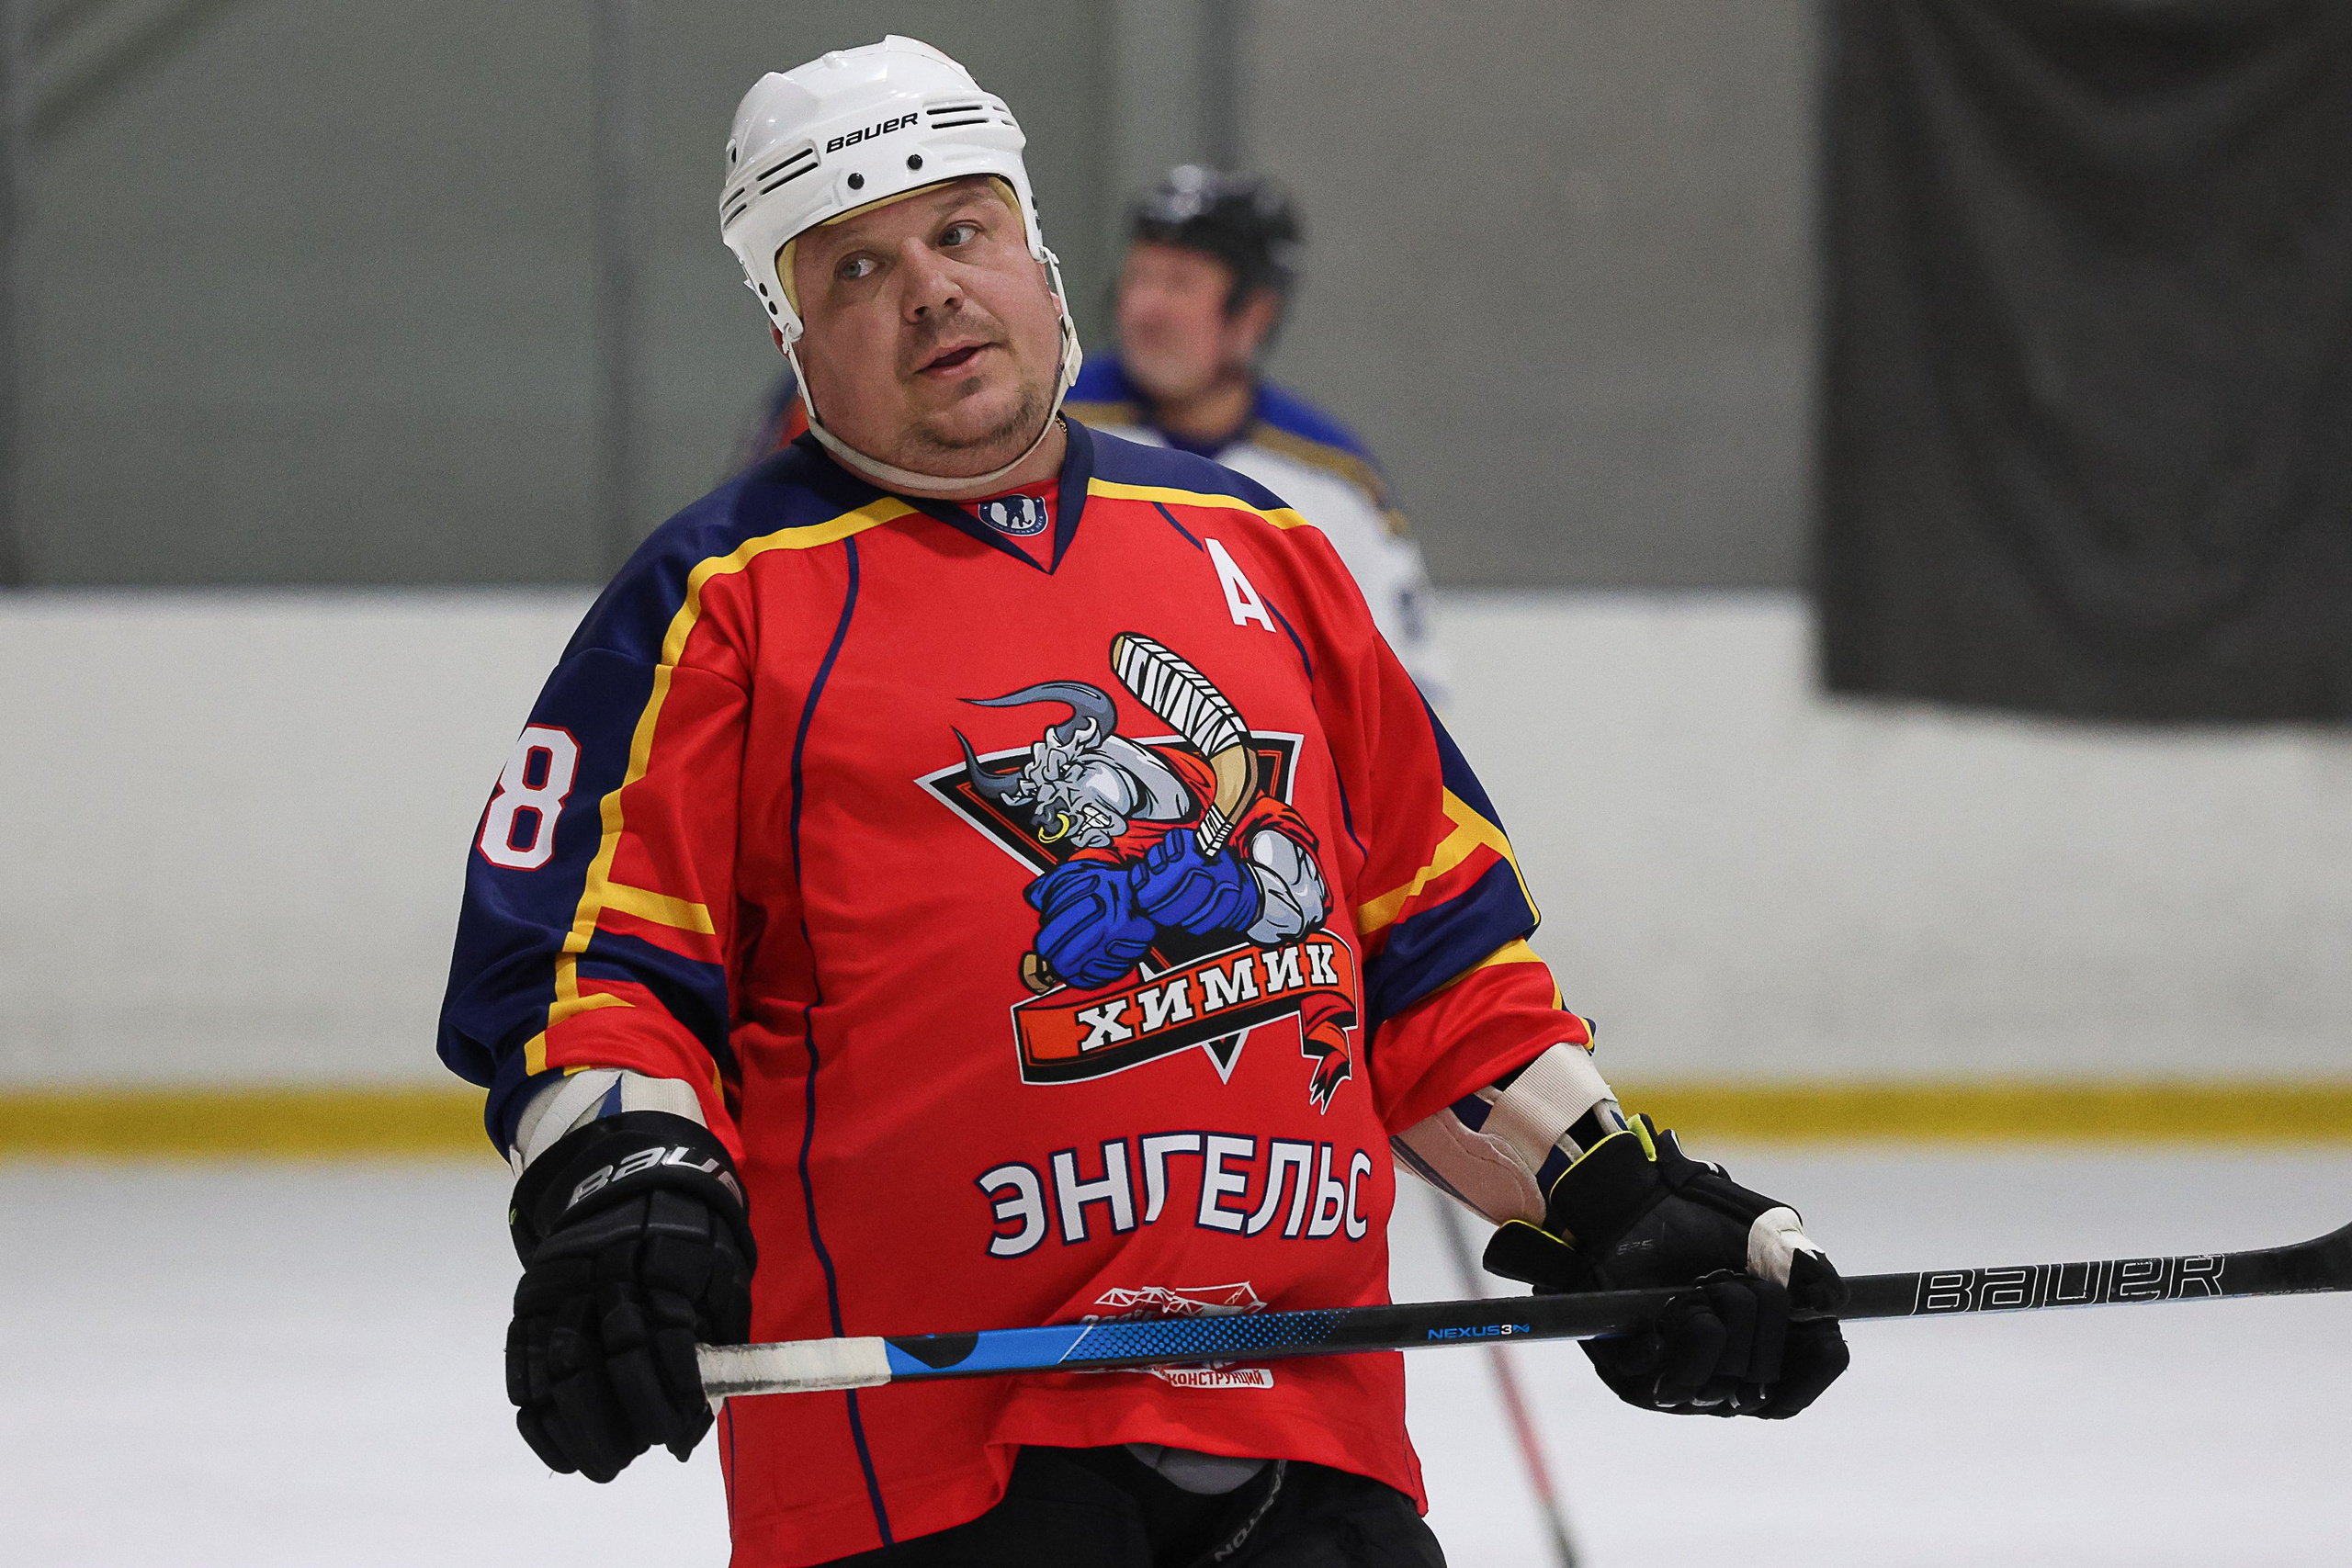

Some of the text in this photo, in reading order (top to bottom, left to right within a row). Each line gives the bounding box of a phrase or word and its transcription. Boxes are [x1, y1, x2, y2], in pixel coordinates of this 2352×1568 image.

[826, 112, 918, 154] BAUER
[1204, 537, 1277, 633] A
[476, 722, 582, 872] 8
[1077, 944, 1339, 1052] ХИМИК
[565, 1146, 744, 1211] BAU
[974, 1131, 1372, 1259] ЭНГЕЛЬС
[1910, 1253, 2225, 1316] BAUER
